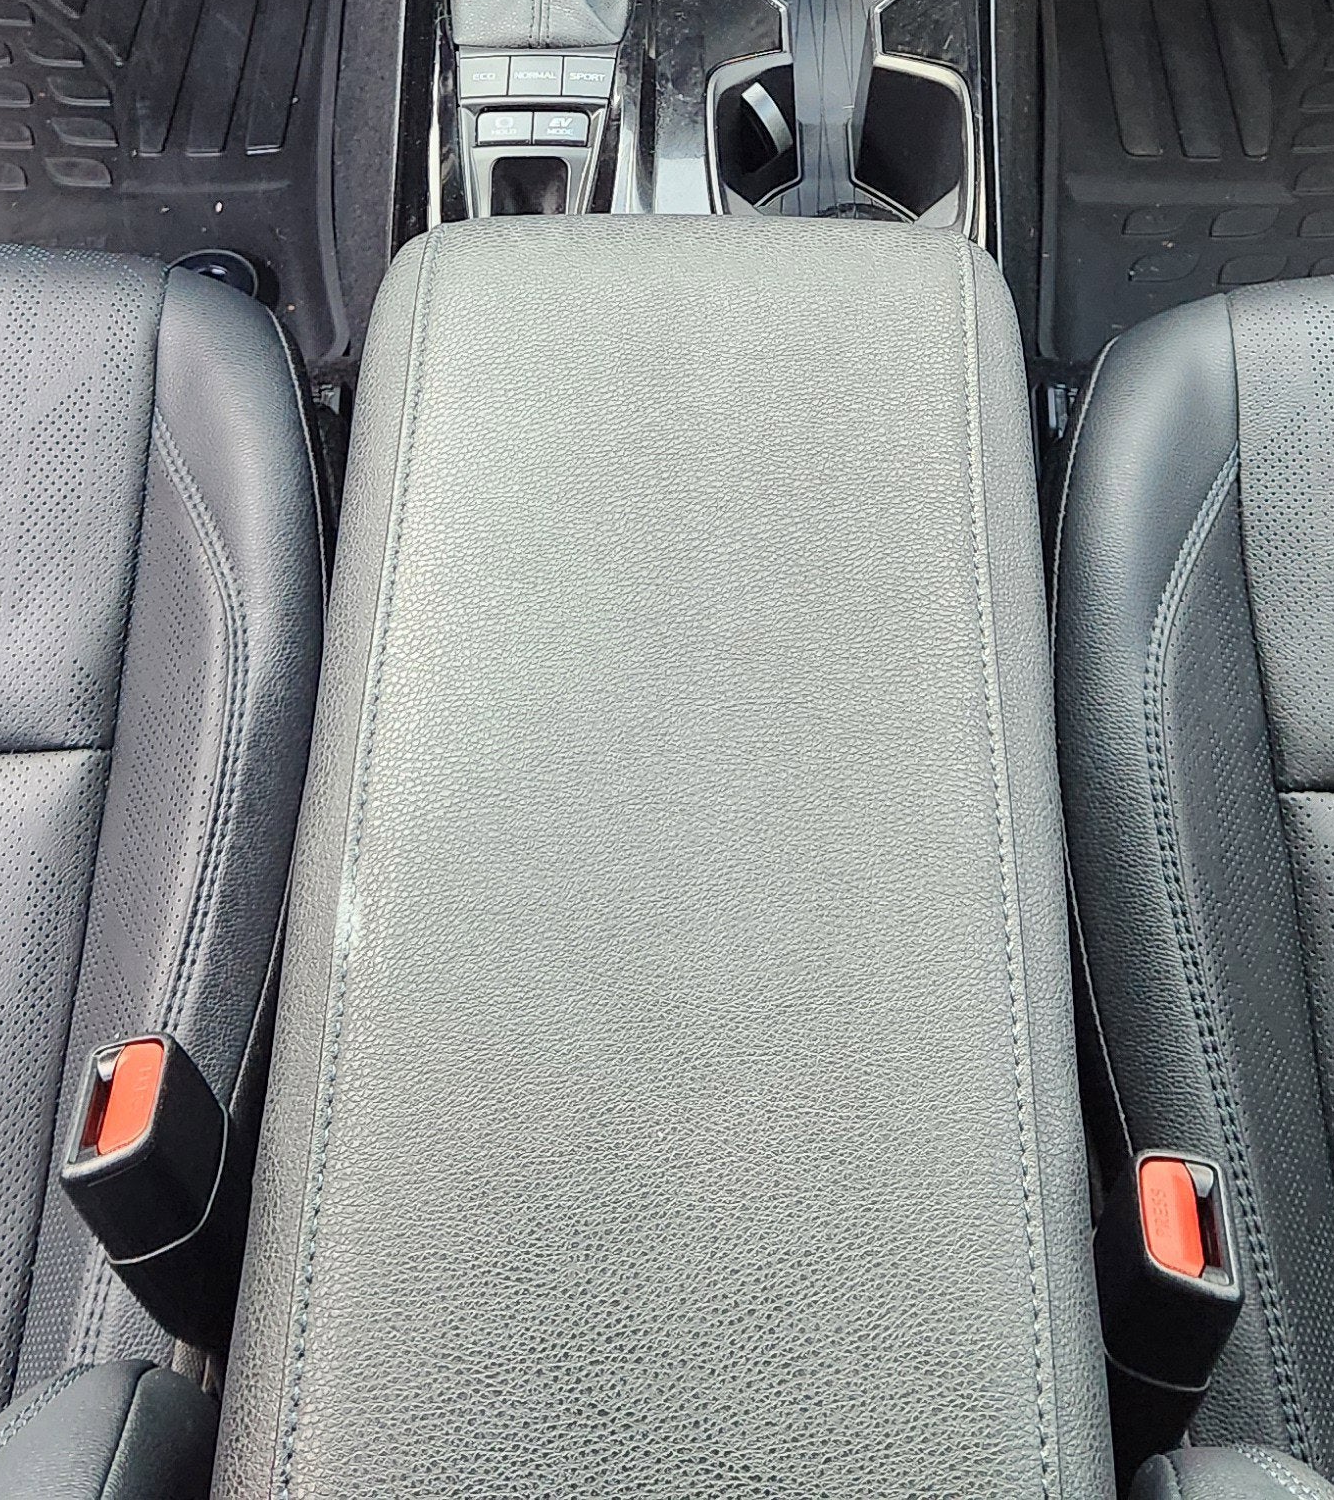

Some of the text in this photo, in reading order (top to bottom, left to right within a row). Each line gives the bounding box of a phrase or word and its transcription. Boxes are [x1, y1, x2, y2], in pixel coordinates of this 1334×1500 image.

[472, 73, 496, 81] ECO
[514, 71, 557, 80] NORMAL
[569, 72, 606, 82] SPORT
[548, 117, 573, 127] EV
[546, 128, 574, 136] MODE
